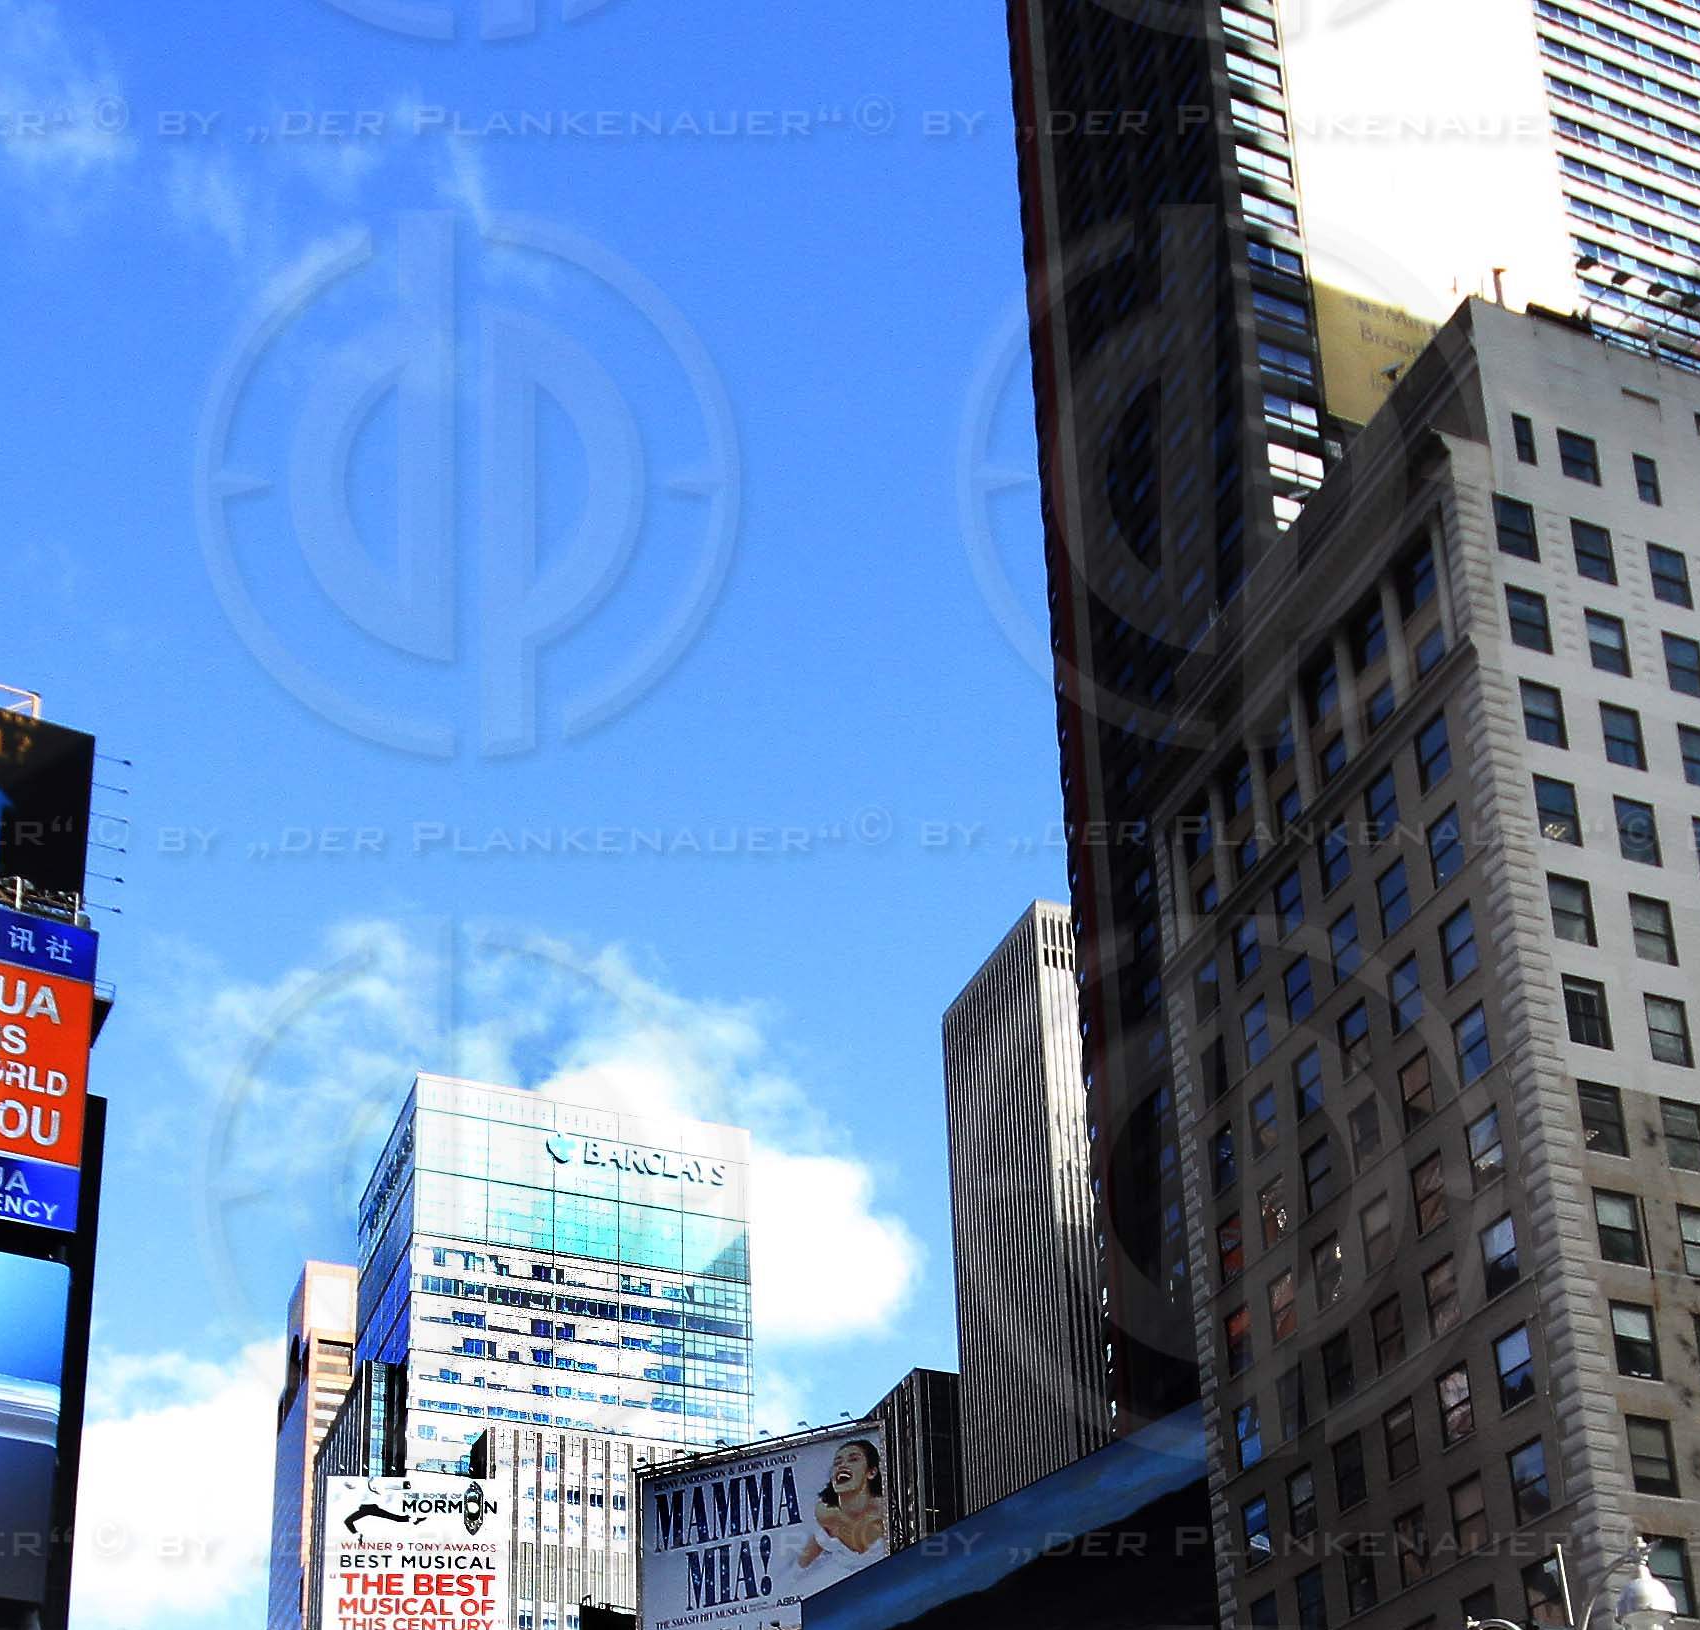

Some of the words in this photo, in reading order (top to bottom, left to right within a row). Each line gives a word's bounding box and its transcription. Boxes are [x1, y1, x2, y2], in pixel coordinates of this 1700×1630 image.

[580, 1136, 728, 1188] BARCLAYS
[654, 1466, 804, 1554] MAMMA
[340, 1541, 393, 1552] WINNER
[396, 1542, 404, 1552] 9
[444, 1543, 497, 1553] AWARDS
[339, 1554, 393, 1569] BEST
[401, 1555, 497, 1570] MUSICAL
[686, 1533, 774, 1612] MIA!
[413, 1573, 497, 1597] BEST
[337, 1597, 453, 1616] MUSICAL
[460, 1599, 496, 1617] OF
